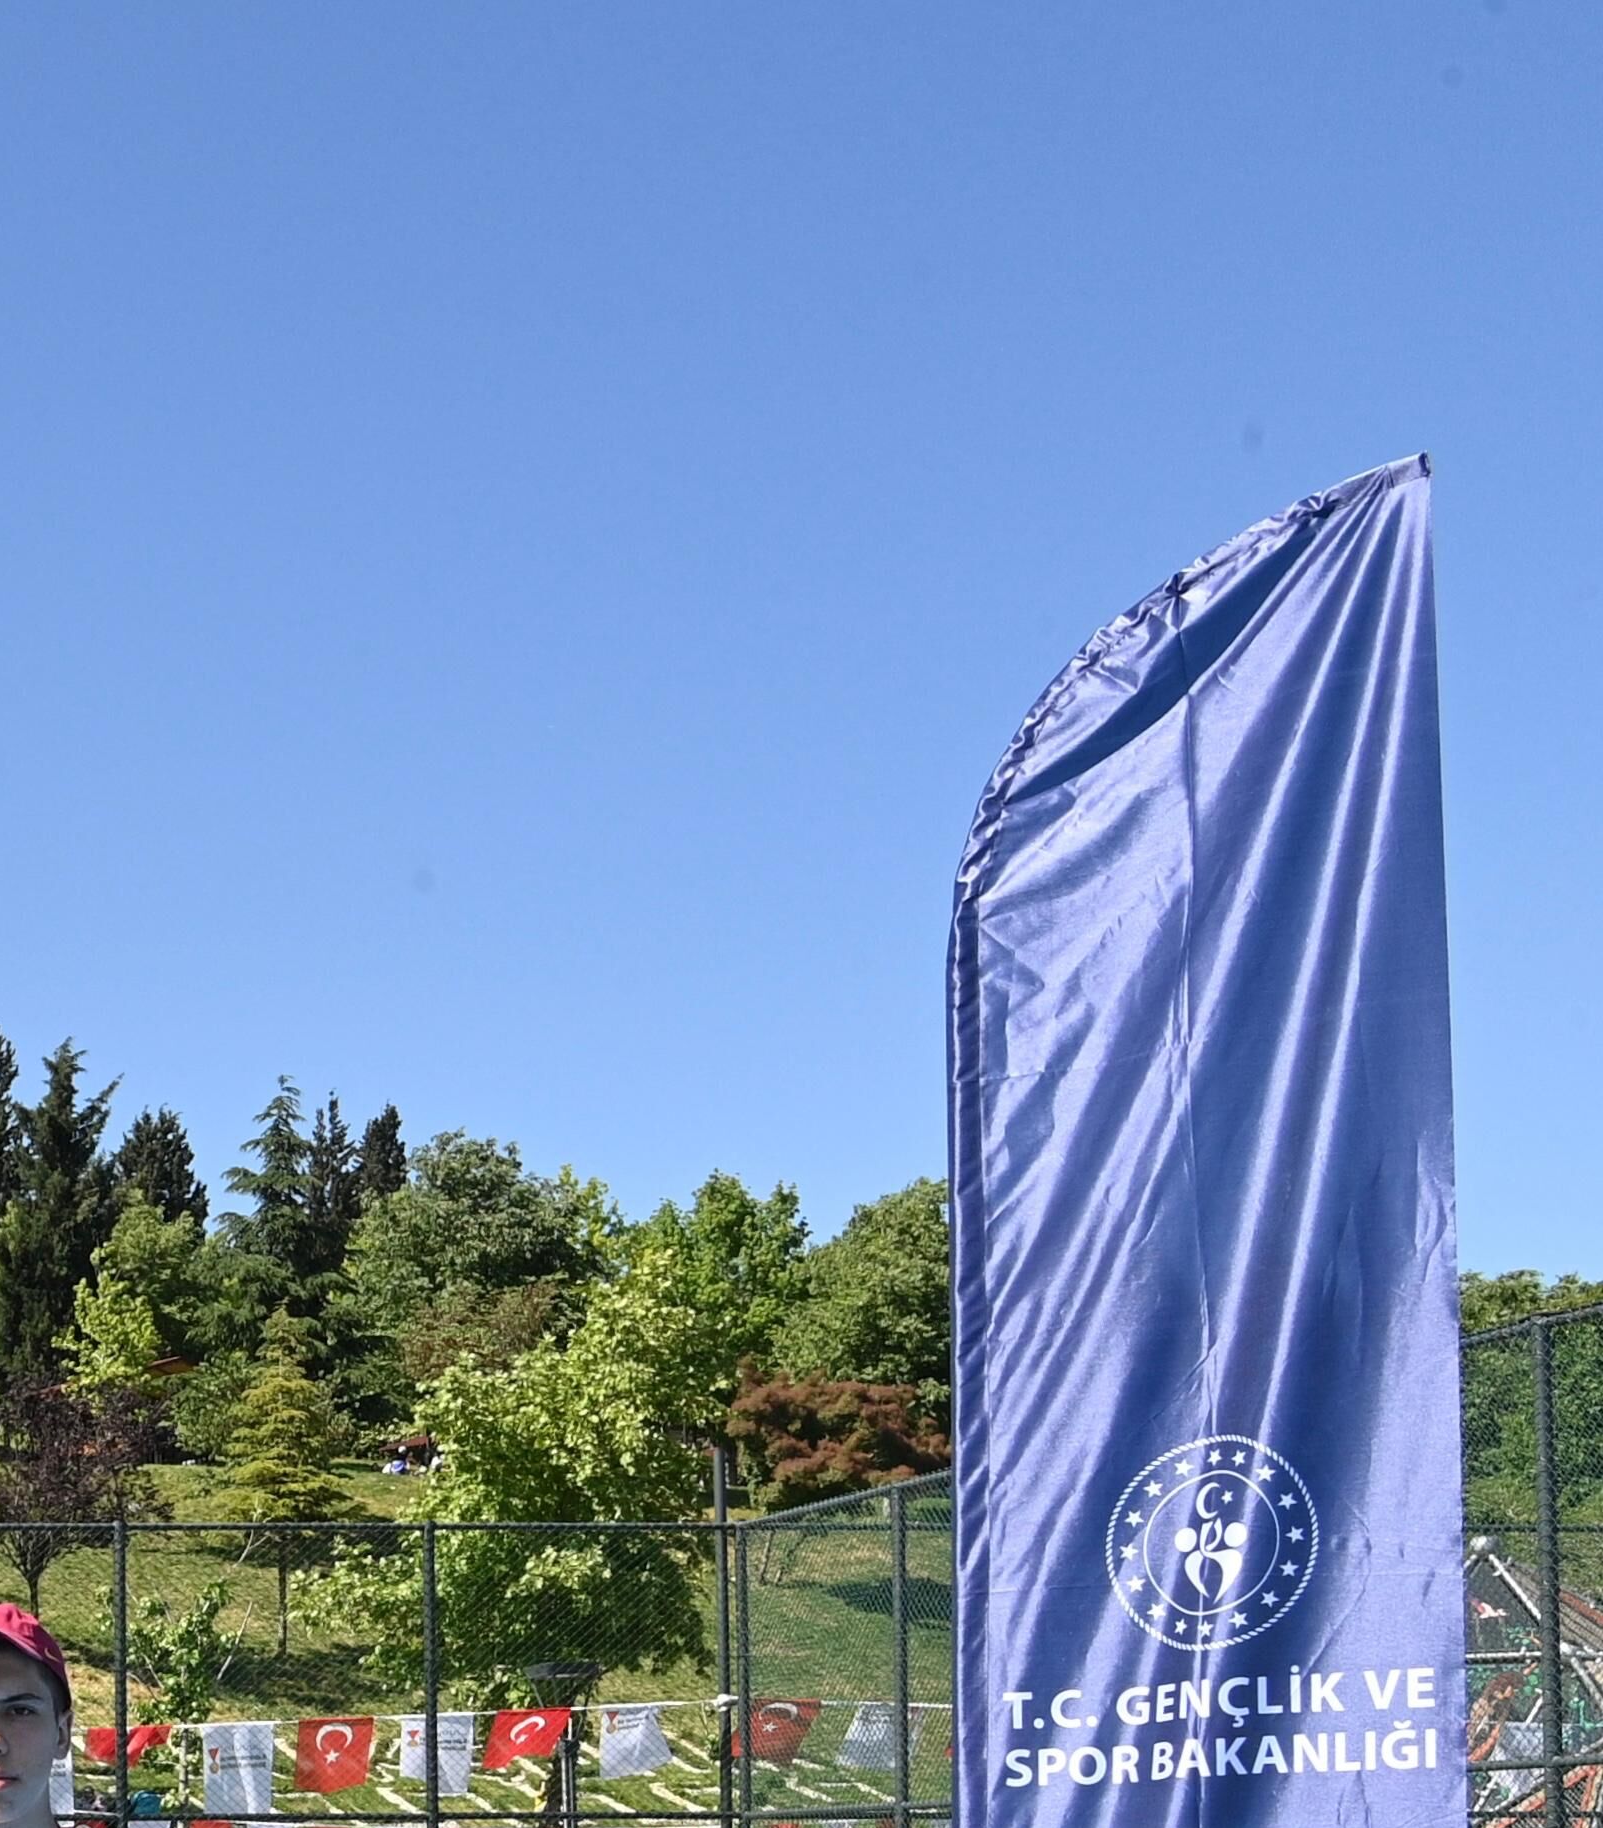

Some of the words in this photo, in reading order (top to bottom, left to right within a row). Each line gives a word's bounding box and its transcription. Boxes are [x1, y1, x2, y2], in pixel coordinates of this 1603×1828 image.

[1002, 1688, 1097, 1730] T.C.
[1116, 1664, 1344, 1728] GENÇLİK
[1363, 1667, 1436, 1710] VE
[1004, 1745, 1140, 1788] SPOR
[1150, 1720, 1438, 1781] BAKANLIĞI
